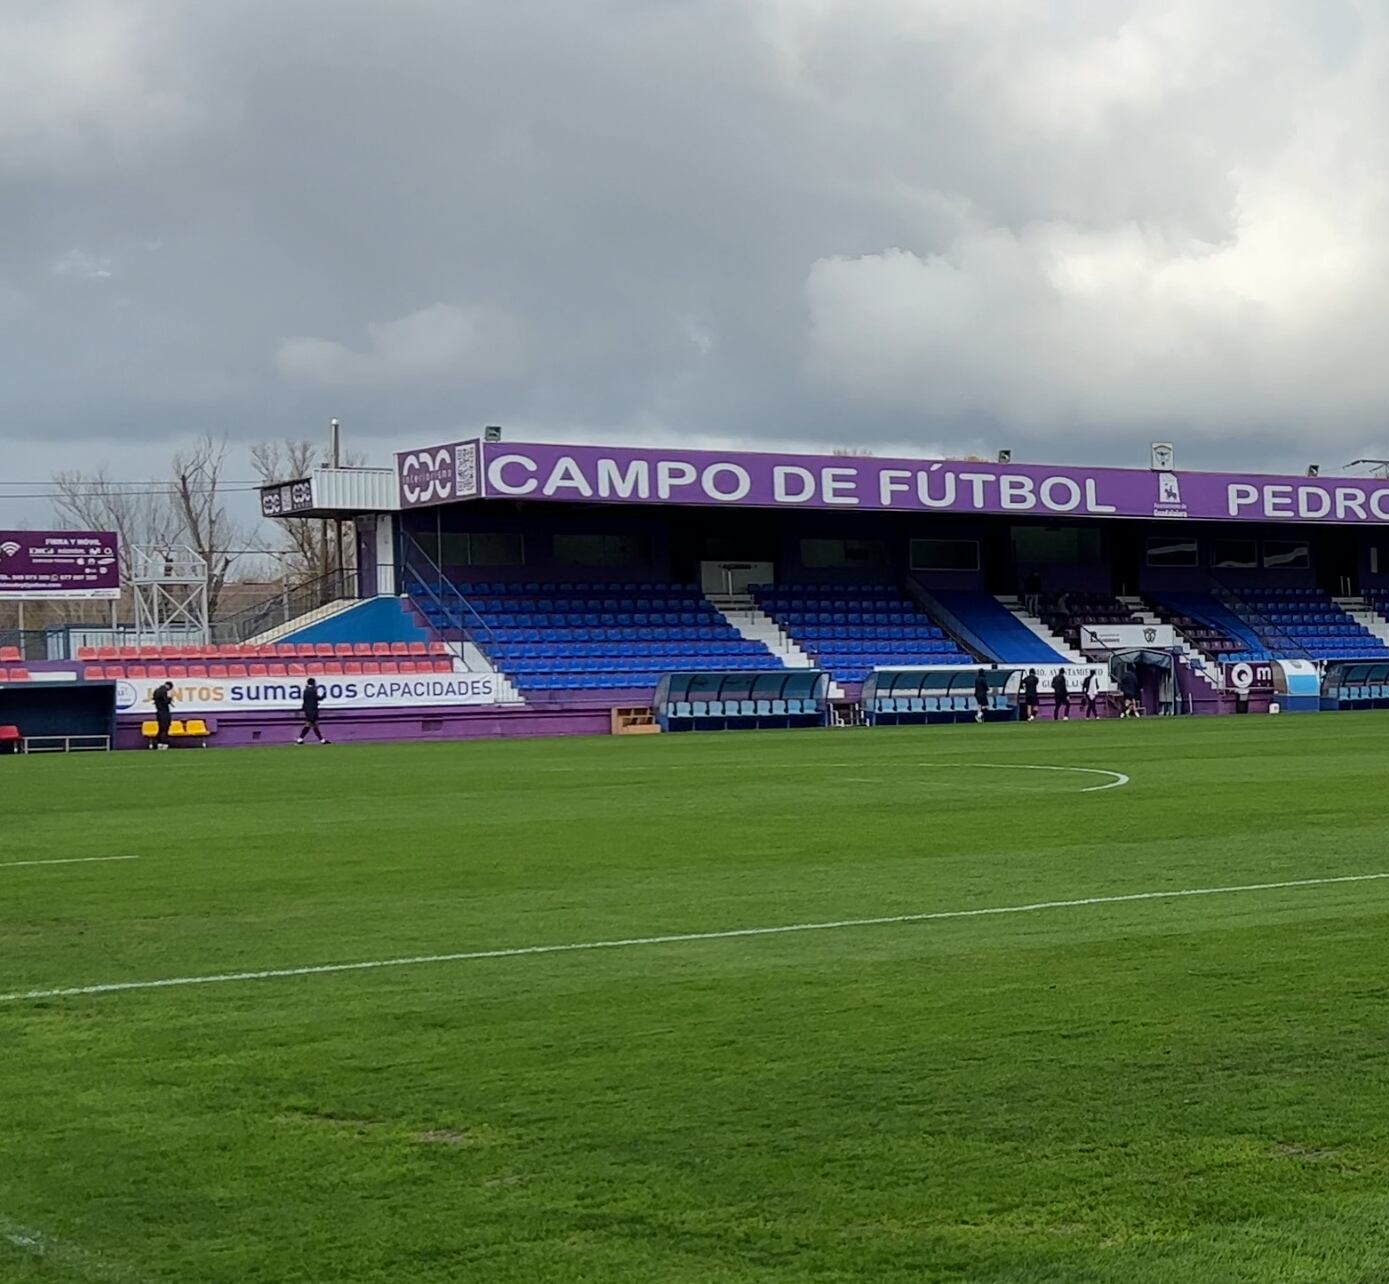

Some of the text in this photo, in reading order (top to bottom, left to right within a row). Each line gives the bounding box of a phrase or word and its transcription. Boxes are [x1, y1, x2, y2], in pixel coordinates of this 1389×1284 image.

[488, 455, 1117, 513] CAMPO DE FÚTBOL
[143, 686, 224, 703] JNTOS
[364, 680, 492, 698] CAPACIDADES
